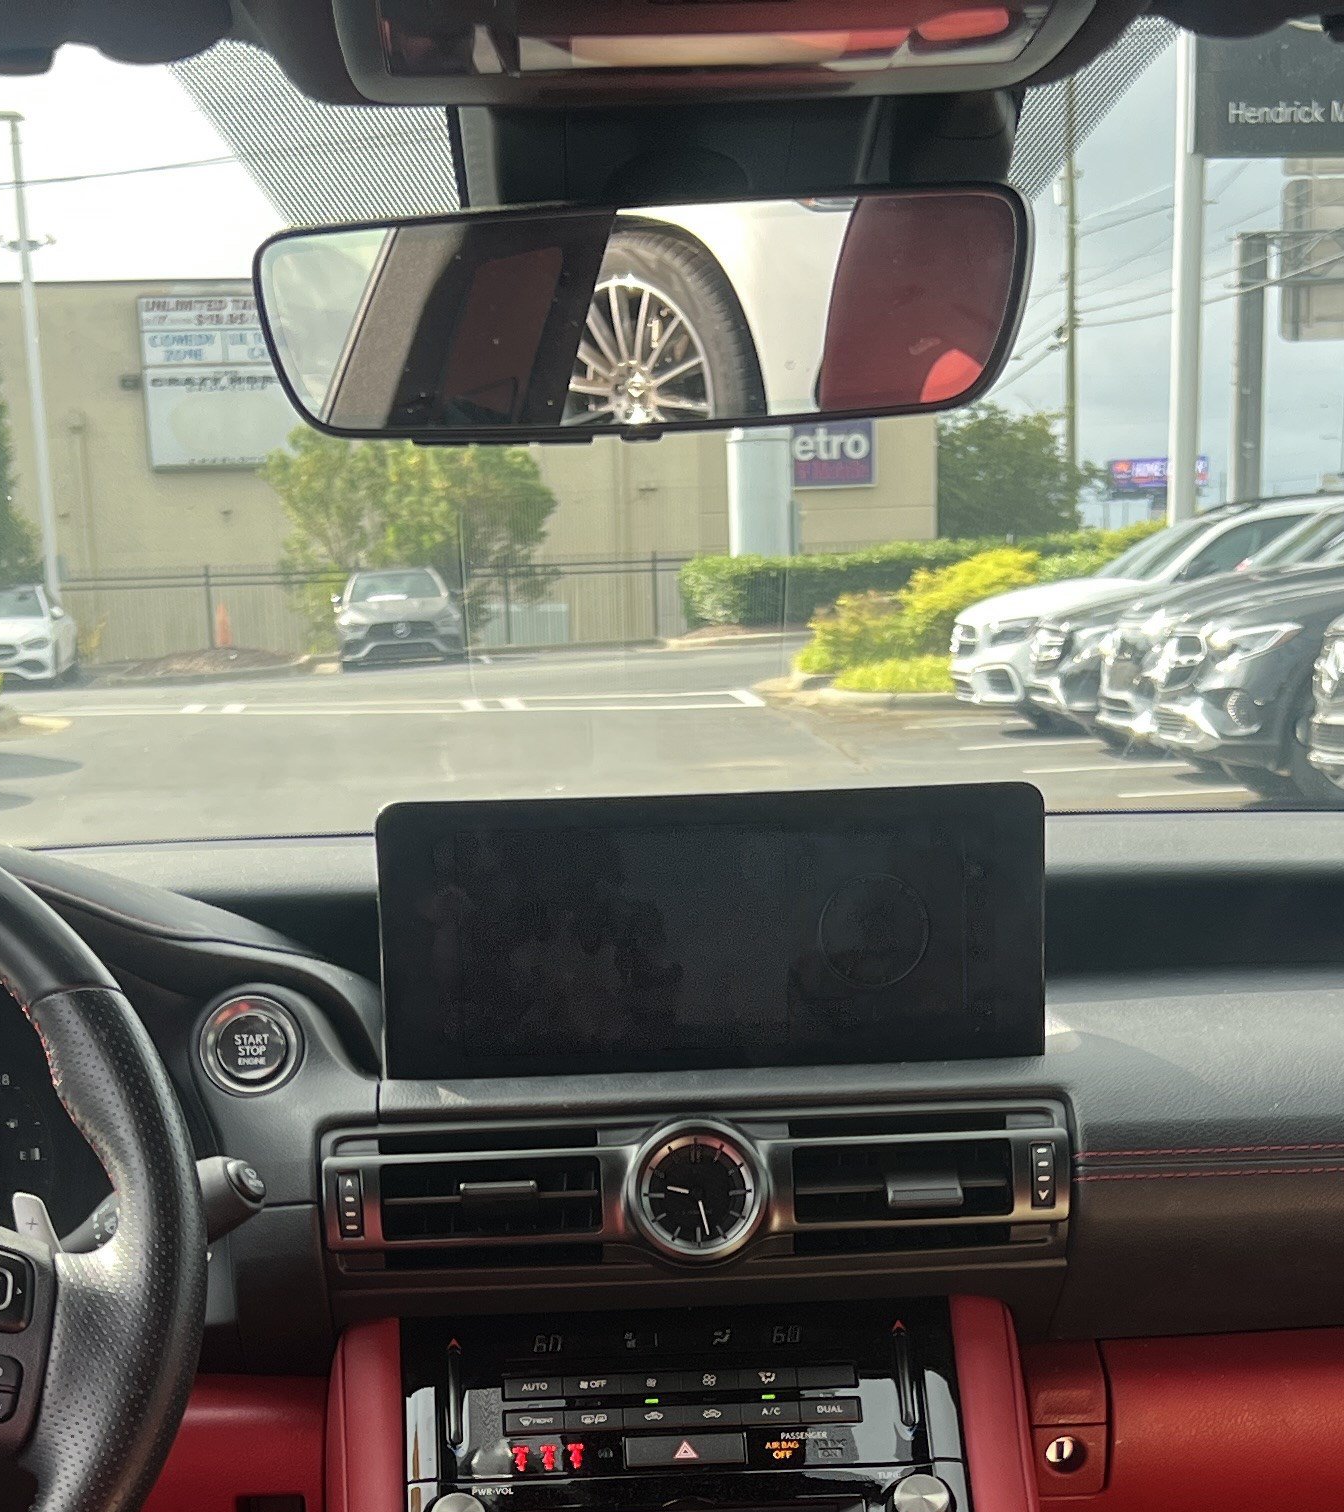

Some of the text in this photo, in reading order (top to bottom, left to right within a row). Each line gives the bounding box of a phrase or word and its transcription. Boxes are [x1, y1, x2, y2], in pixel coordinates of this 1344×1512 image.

[1228, 99, 1325, 124] Hendrick
[233, 1034, 270, 1047] START
[237, 1046, 267, 1058] STOP
[237, 1056, 267, 1067] ENGINE
[521, 1382, 548, 1392] AUTO
[589, 1379, 607, 1390] OFF
[761, 1406, 782, 1416] A/C
[816, 1404, 844, 1415] DUAL
[780, 1431, 828, 1441] PASSENGER
[772, 1449, 793, 1460] OFF
